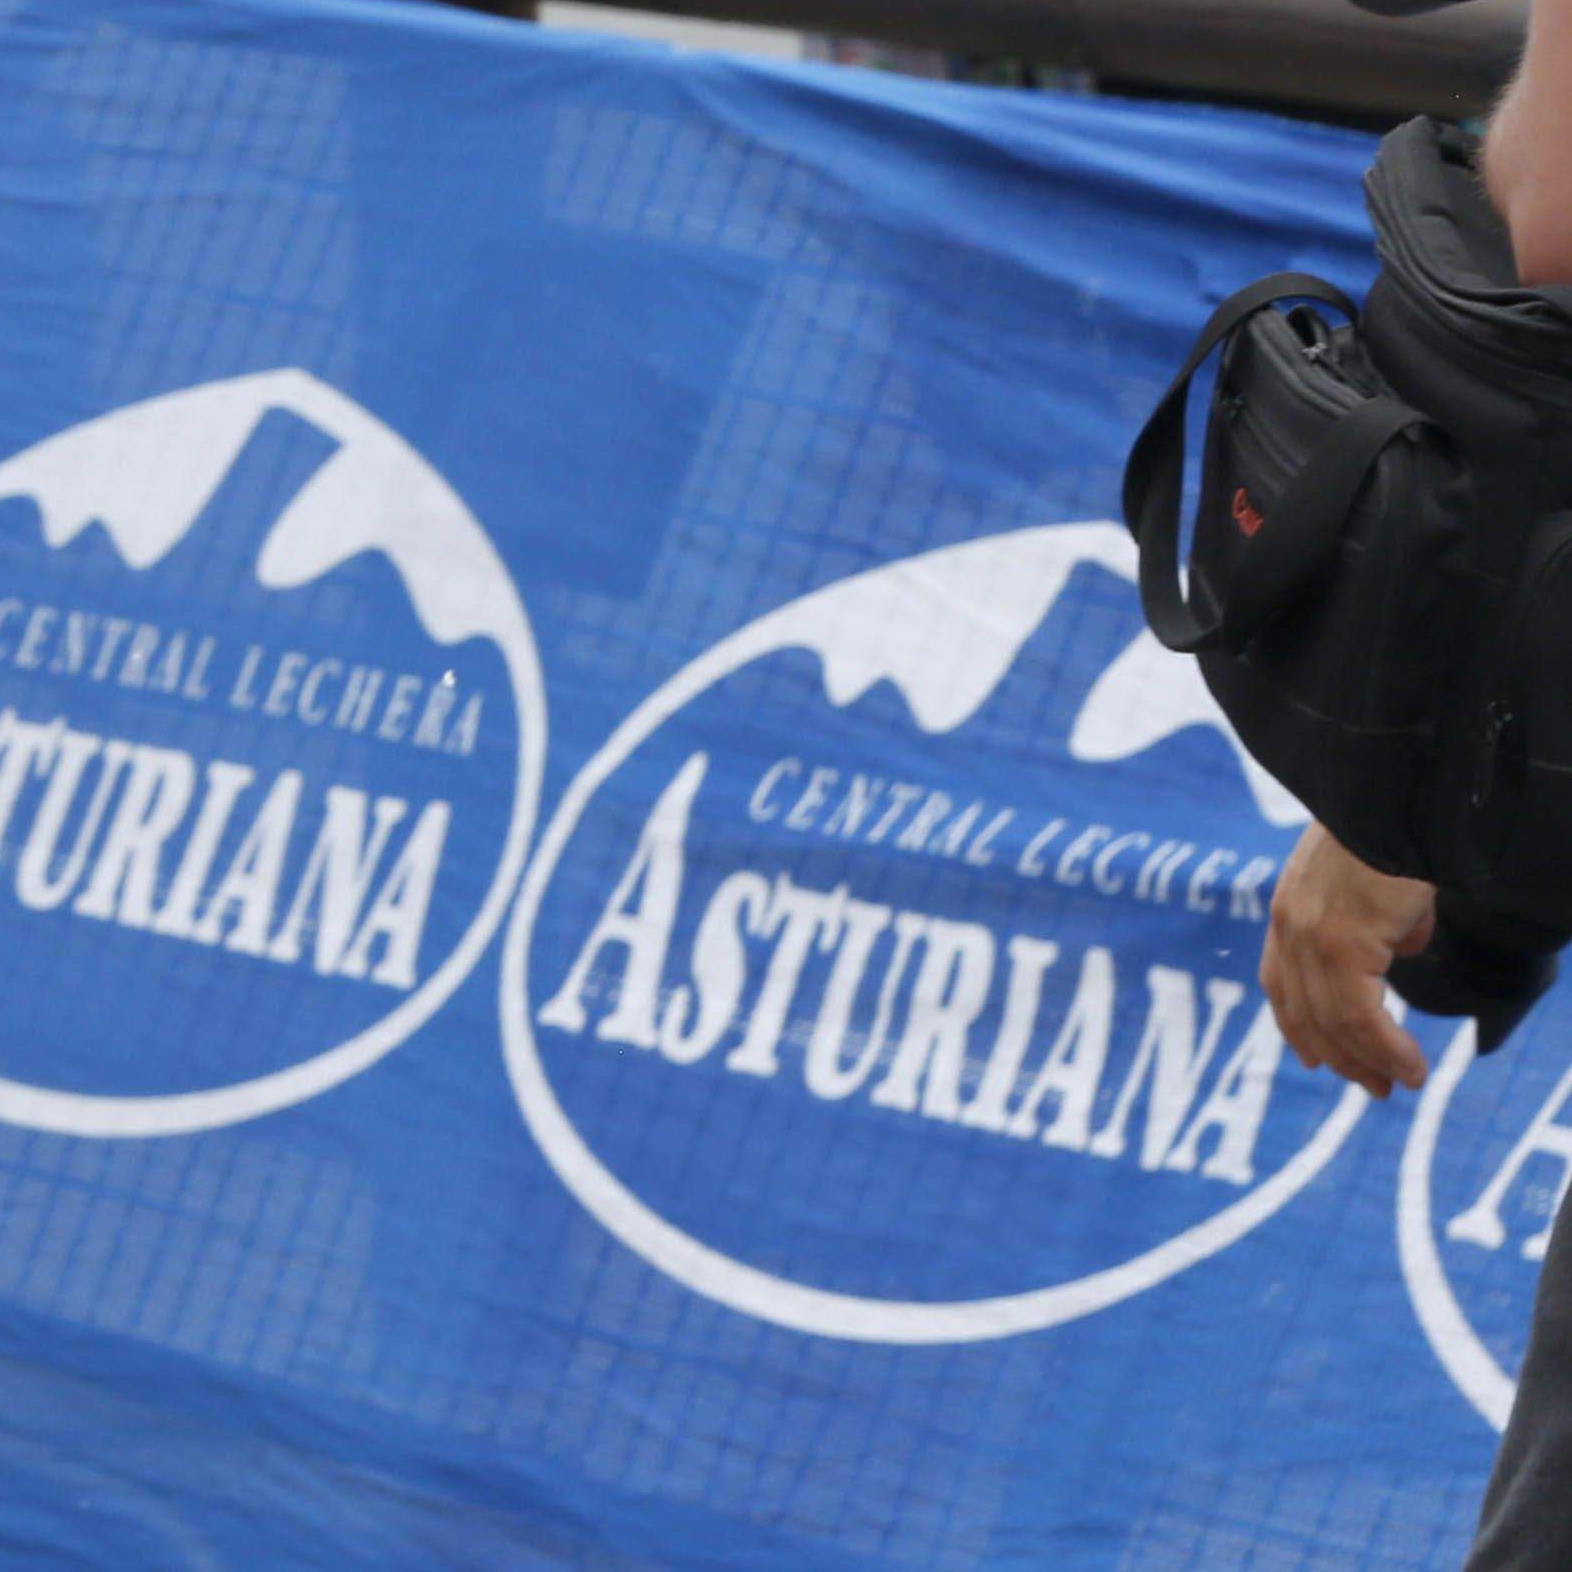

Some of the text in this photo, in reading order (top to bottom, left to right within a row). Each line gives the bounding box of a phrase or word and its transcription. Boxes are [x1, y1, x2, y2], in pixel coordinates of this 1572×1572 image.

[231, 646, 485, 756] LECHERA
[747, 756, 1014, 867] CENTRAL
[540, 751, 1283, 1183] ASTURIANA
